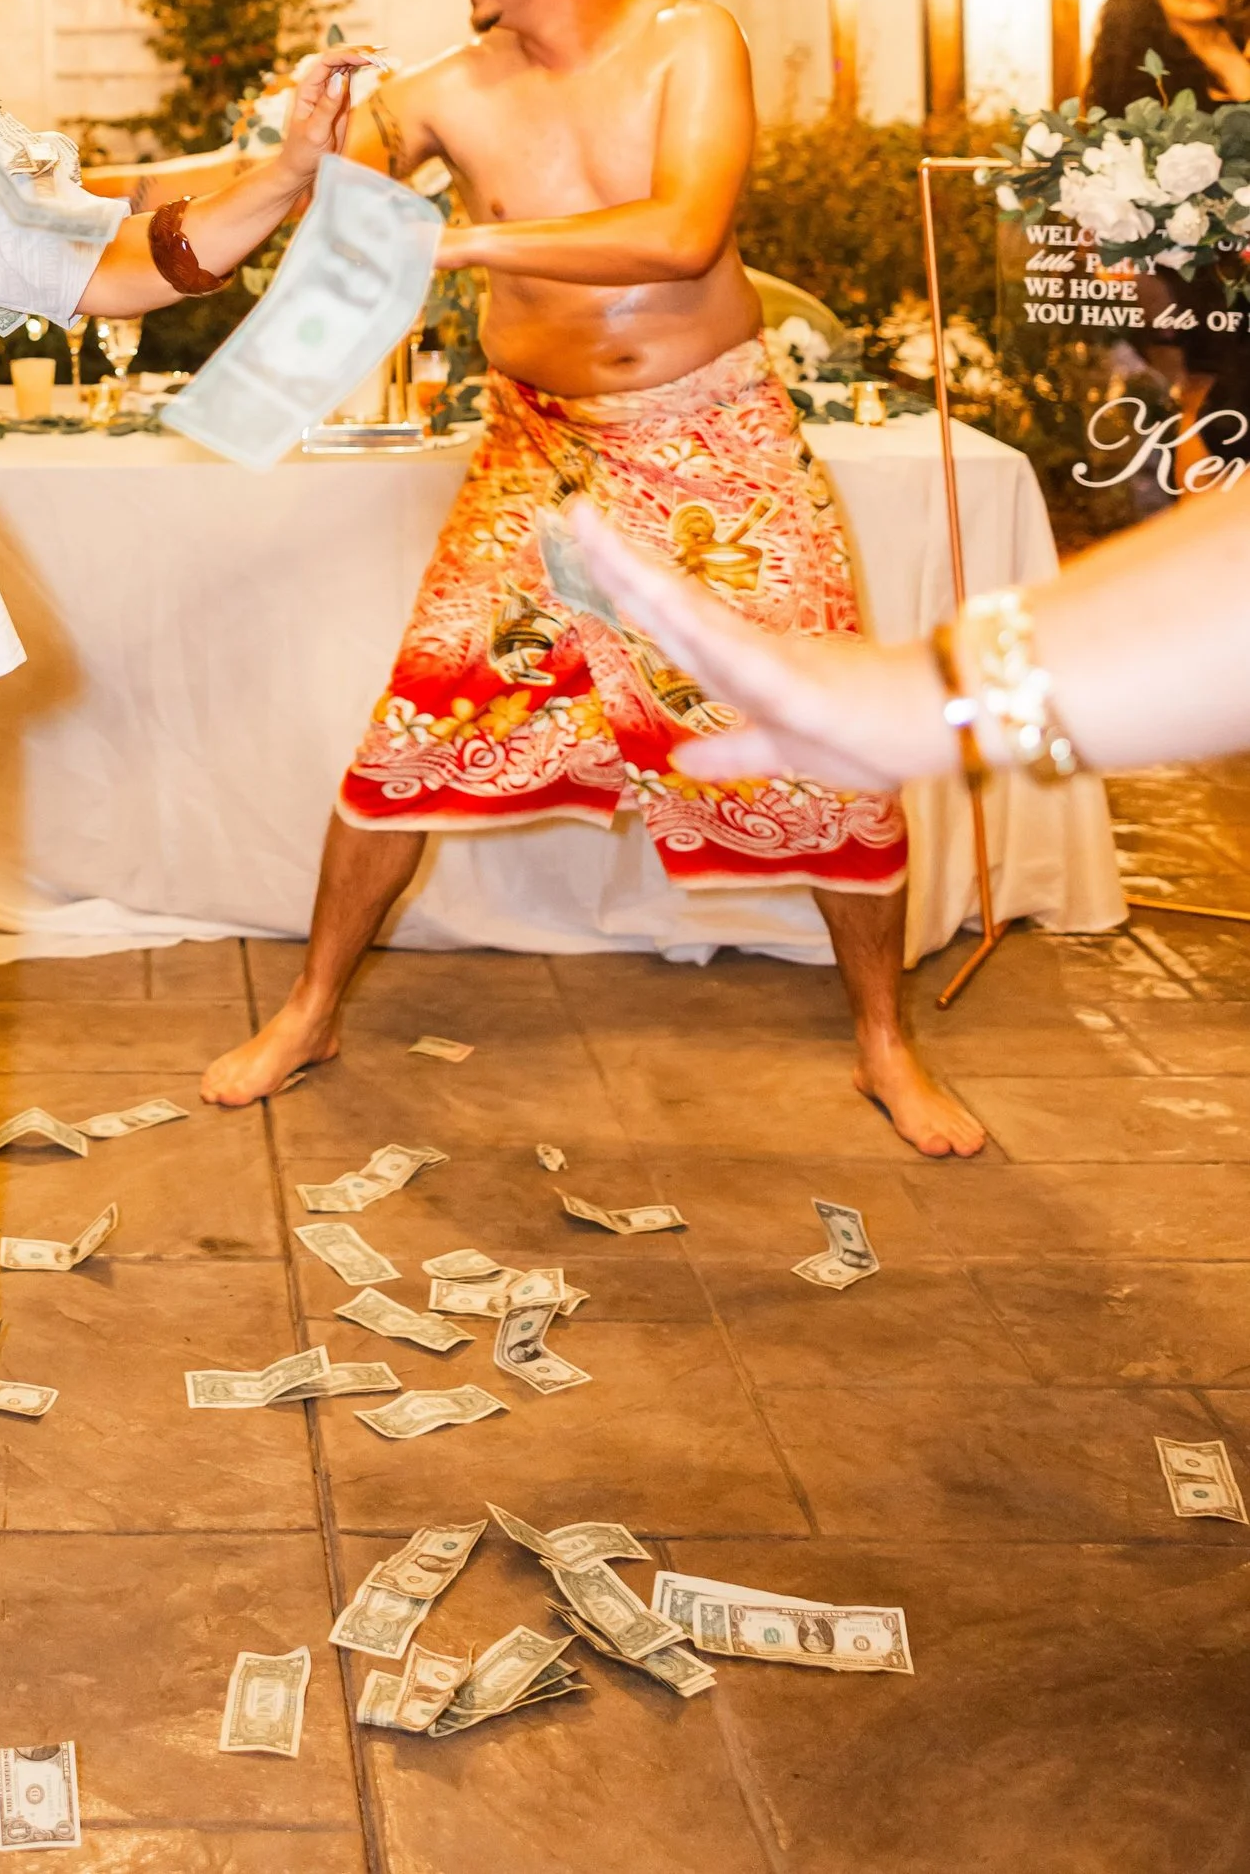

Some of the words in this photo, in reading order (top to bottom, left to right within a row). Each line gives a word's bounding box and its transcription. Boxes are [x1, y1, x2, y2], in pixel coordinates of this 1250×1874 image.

[1024, 276, 1065, 298] WE
[1069, 278, 1139, 301] HOPE
[1023, 302, 1076, 325] YOU
[1080, 305, 1146, 328] HAVE
[1152, 303, 1199, 330] lots
[1206, 310, 1244, 333] OF
